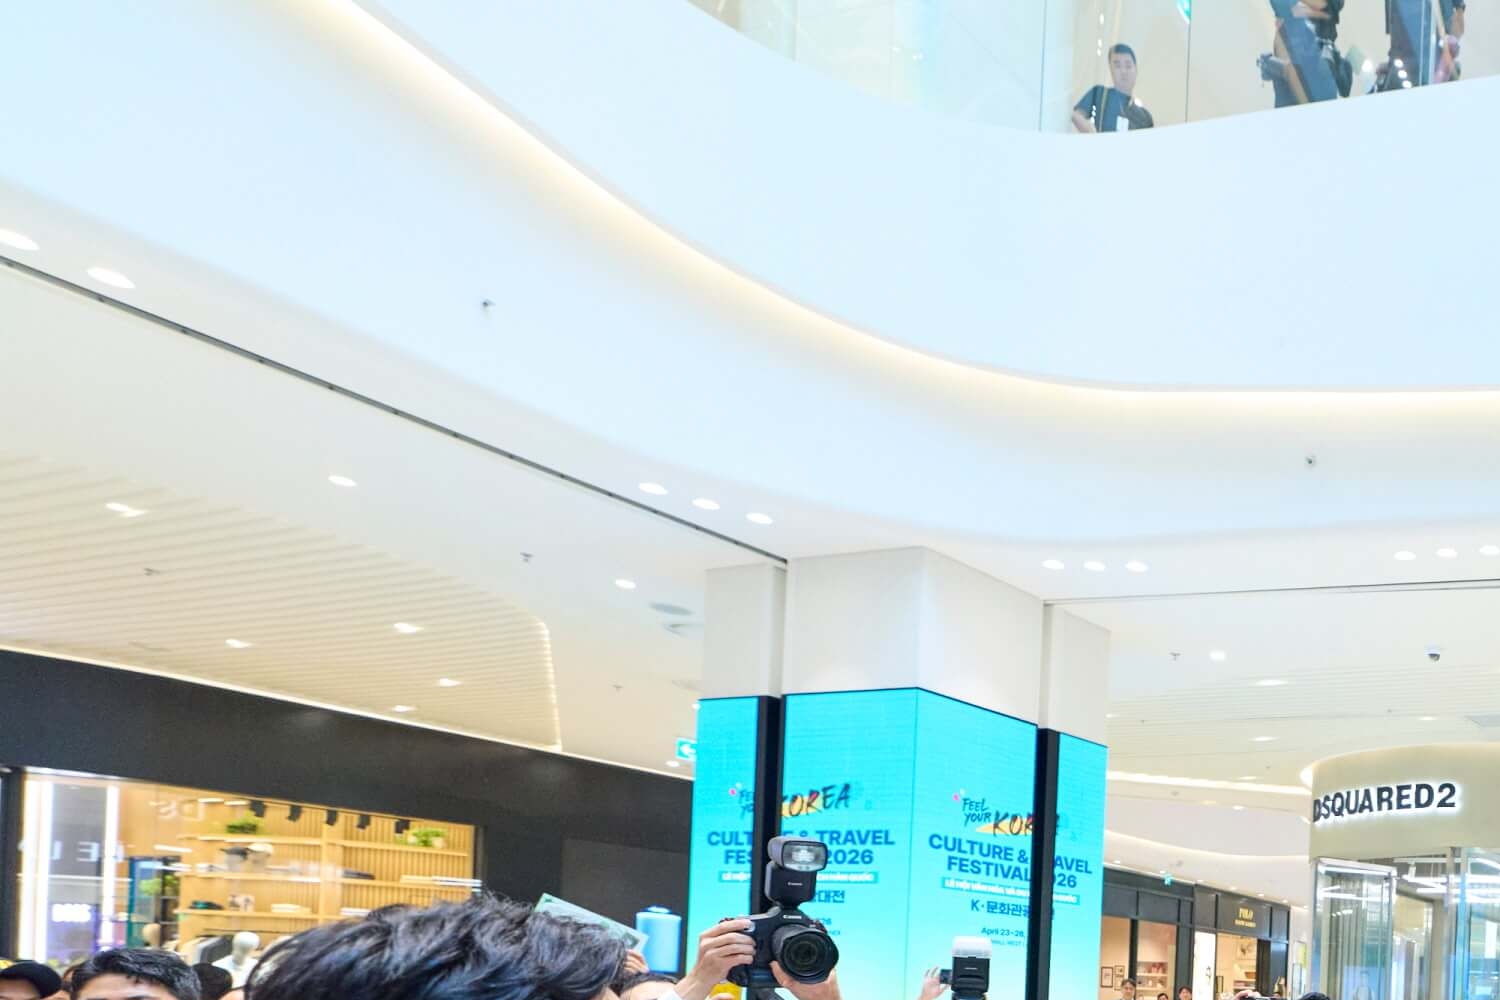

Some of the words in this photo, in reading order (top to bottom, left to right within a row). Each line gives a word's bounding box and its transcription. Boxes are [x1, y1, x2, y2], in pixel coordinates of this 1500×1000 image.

[961, 797, 988, 813] FEEL
[1313, 782, 1457, 824] DSQUARED2
[963, 811, 992, 827] YOUR
[815, 829, 896, 846] TRAVEL
[928, 833, 1014, 863] CULTURE
[1017, 853, 1029, 865] &
[1054, 855, 1094, 875] AVEL
[946, 855, 1031, 883] FESTIVAL
[1054, 872, 1078, 889] 26
